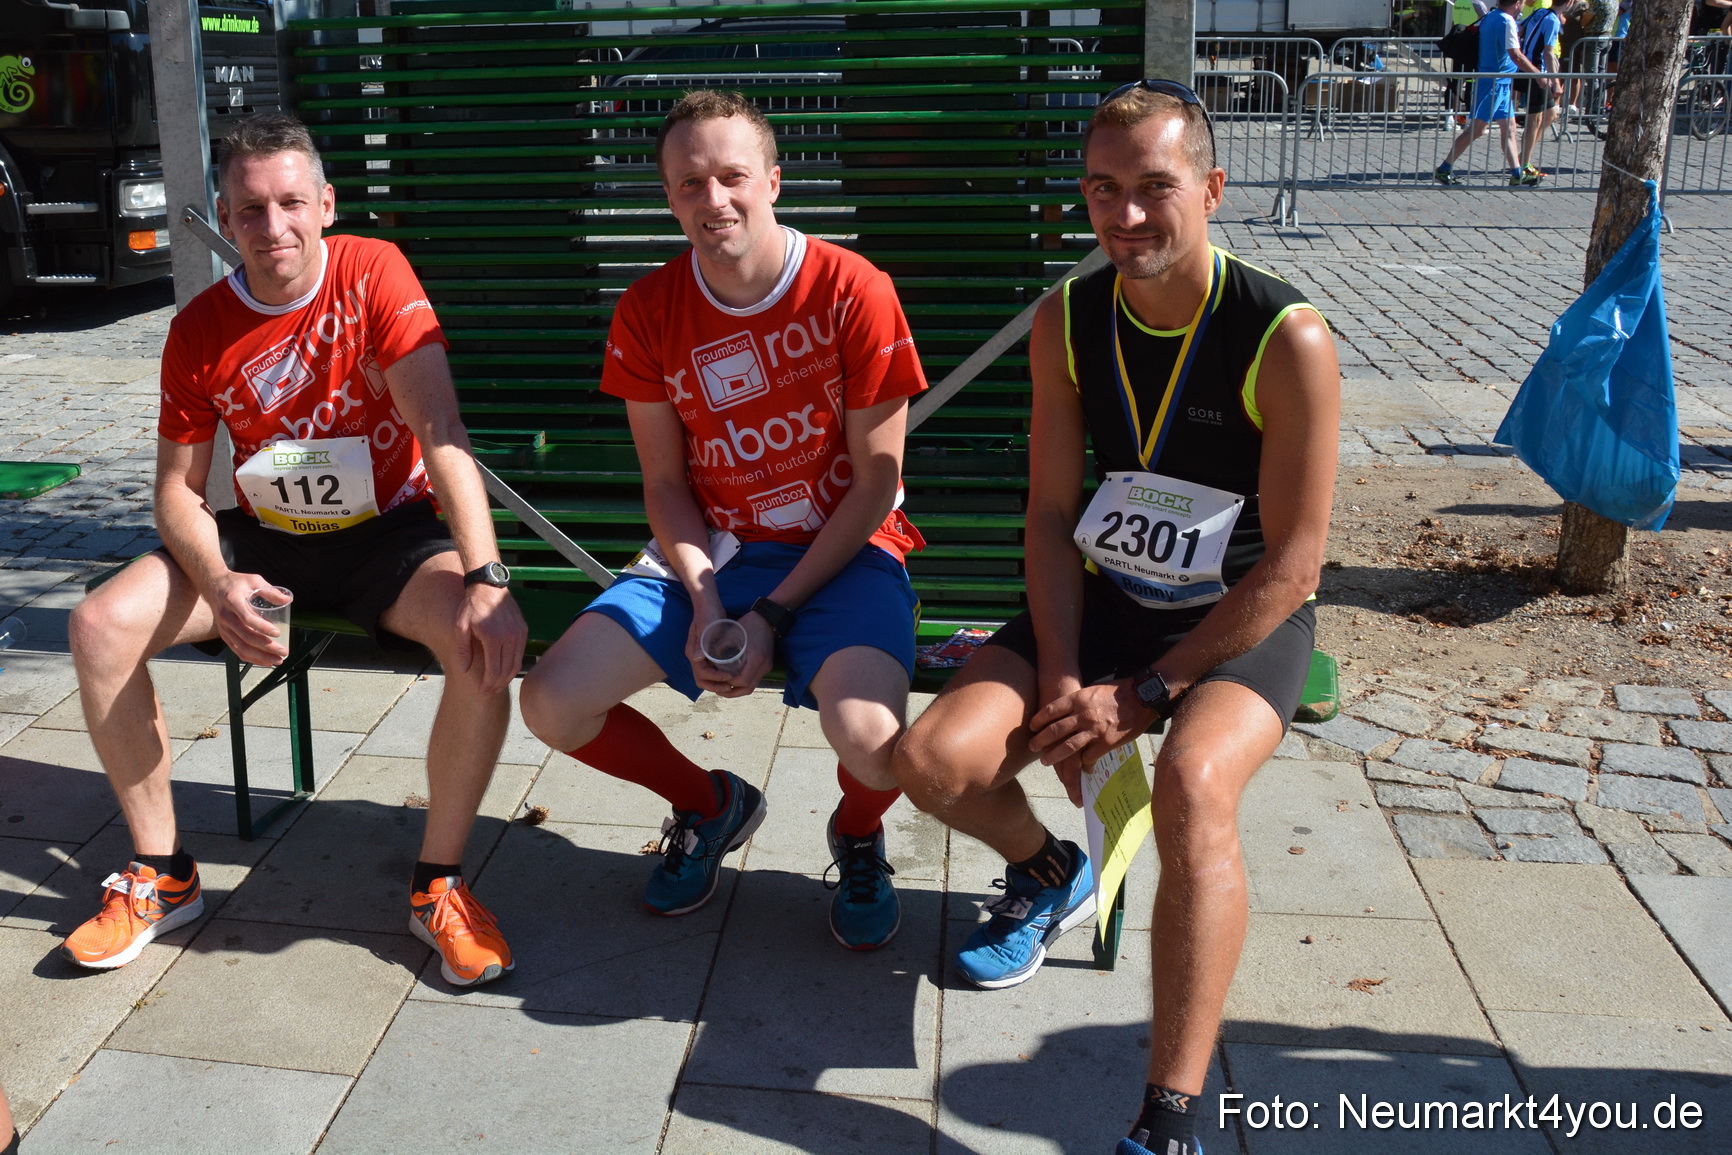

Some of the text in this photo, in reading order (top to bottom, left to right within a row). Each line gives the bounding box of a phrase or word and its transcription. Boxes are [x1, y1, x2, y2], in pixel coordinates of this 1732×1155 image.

[201, 14, 259, 33] www.drinknow.de
[215, 66, 254, 83] MAN
[697, 337, 750, 366] raumbox
[1188, 406, 1222, 421] GORE
[273, 451, 331, 466] BOCK
[775, 440, 831, 473] outdoor
[270, 474, 343, 505] 112
[1128, 486, 1194, 513] BOCK
[274, 505, 339, 516] PARTL Neumarkt
[289, 519, 340, 532] Tobias
[1095, 511, 1201, 569] 2301
[1104, 556, 1176, 581] PARTL Neumarkt
[1122, 576, 1175, 603] Ronny
